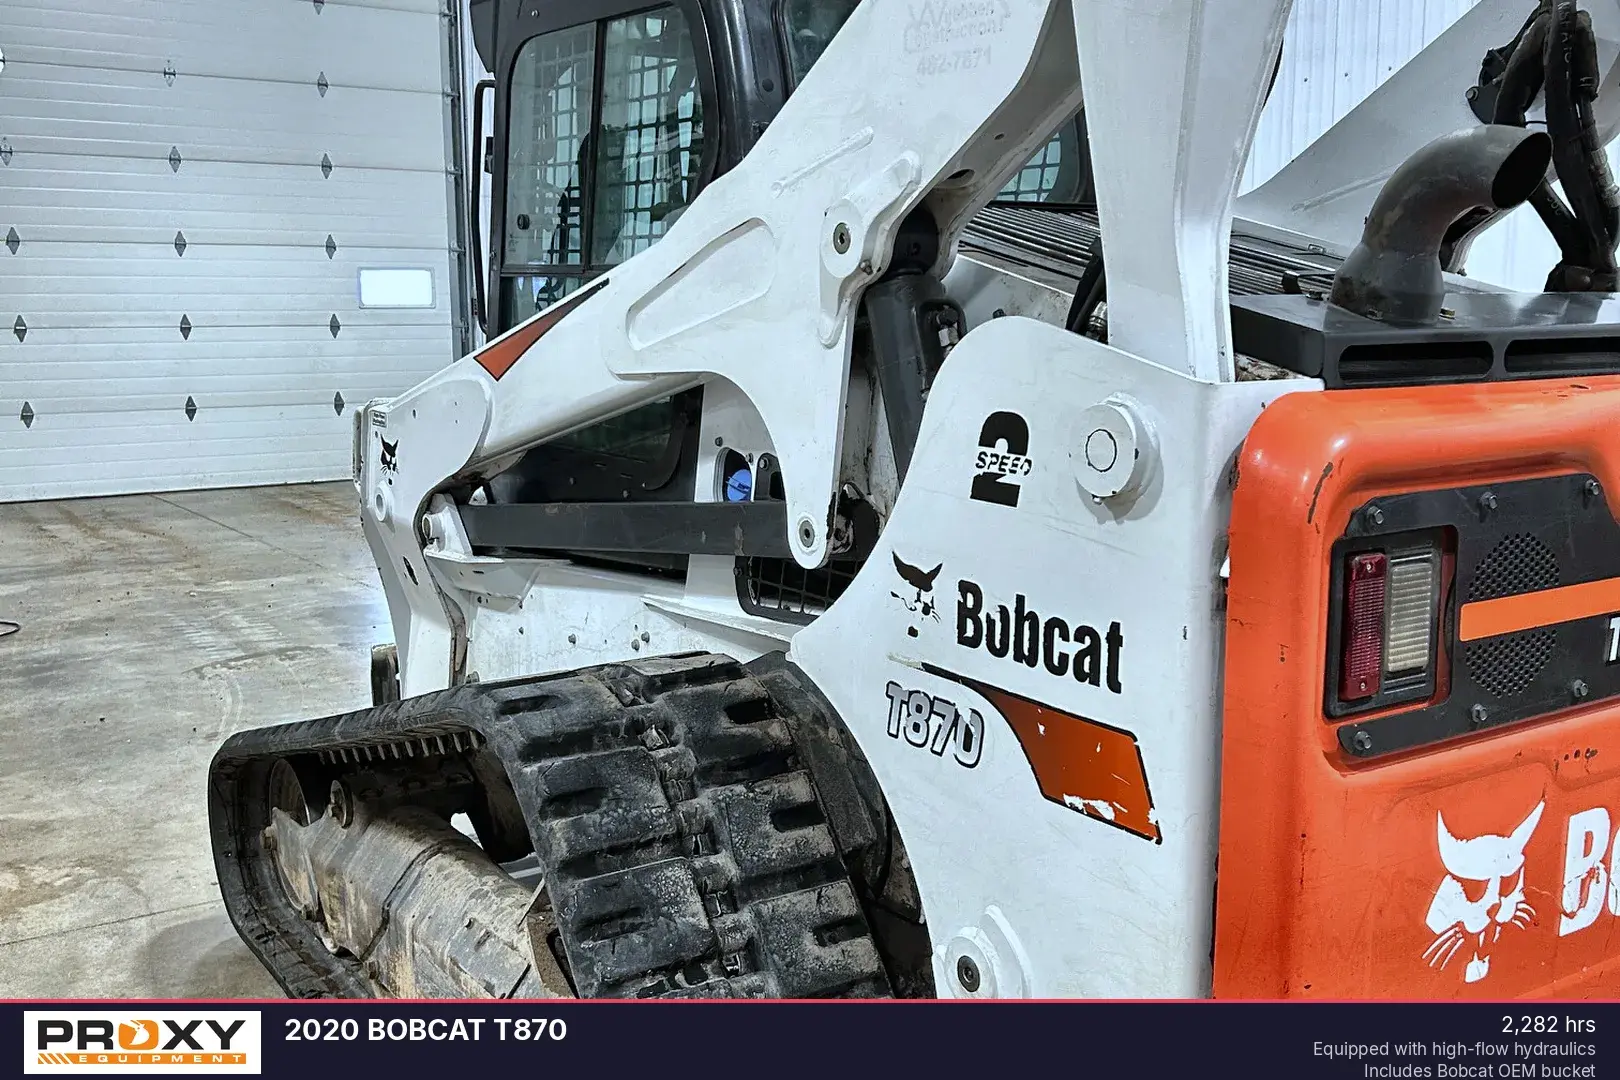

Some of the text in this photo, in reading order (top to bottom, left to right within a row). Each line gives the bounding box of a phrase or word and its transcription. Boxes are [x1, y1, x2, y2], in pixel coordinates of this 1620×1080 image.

[970, 411, 1029, 507] 2
[975, 450, 1033, 476] SPEED
[957, 579, 1124, 694] Bobcat
[886, 681, 984, 769] T870
[1558, 806, 1620, 937] B
